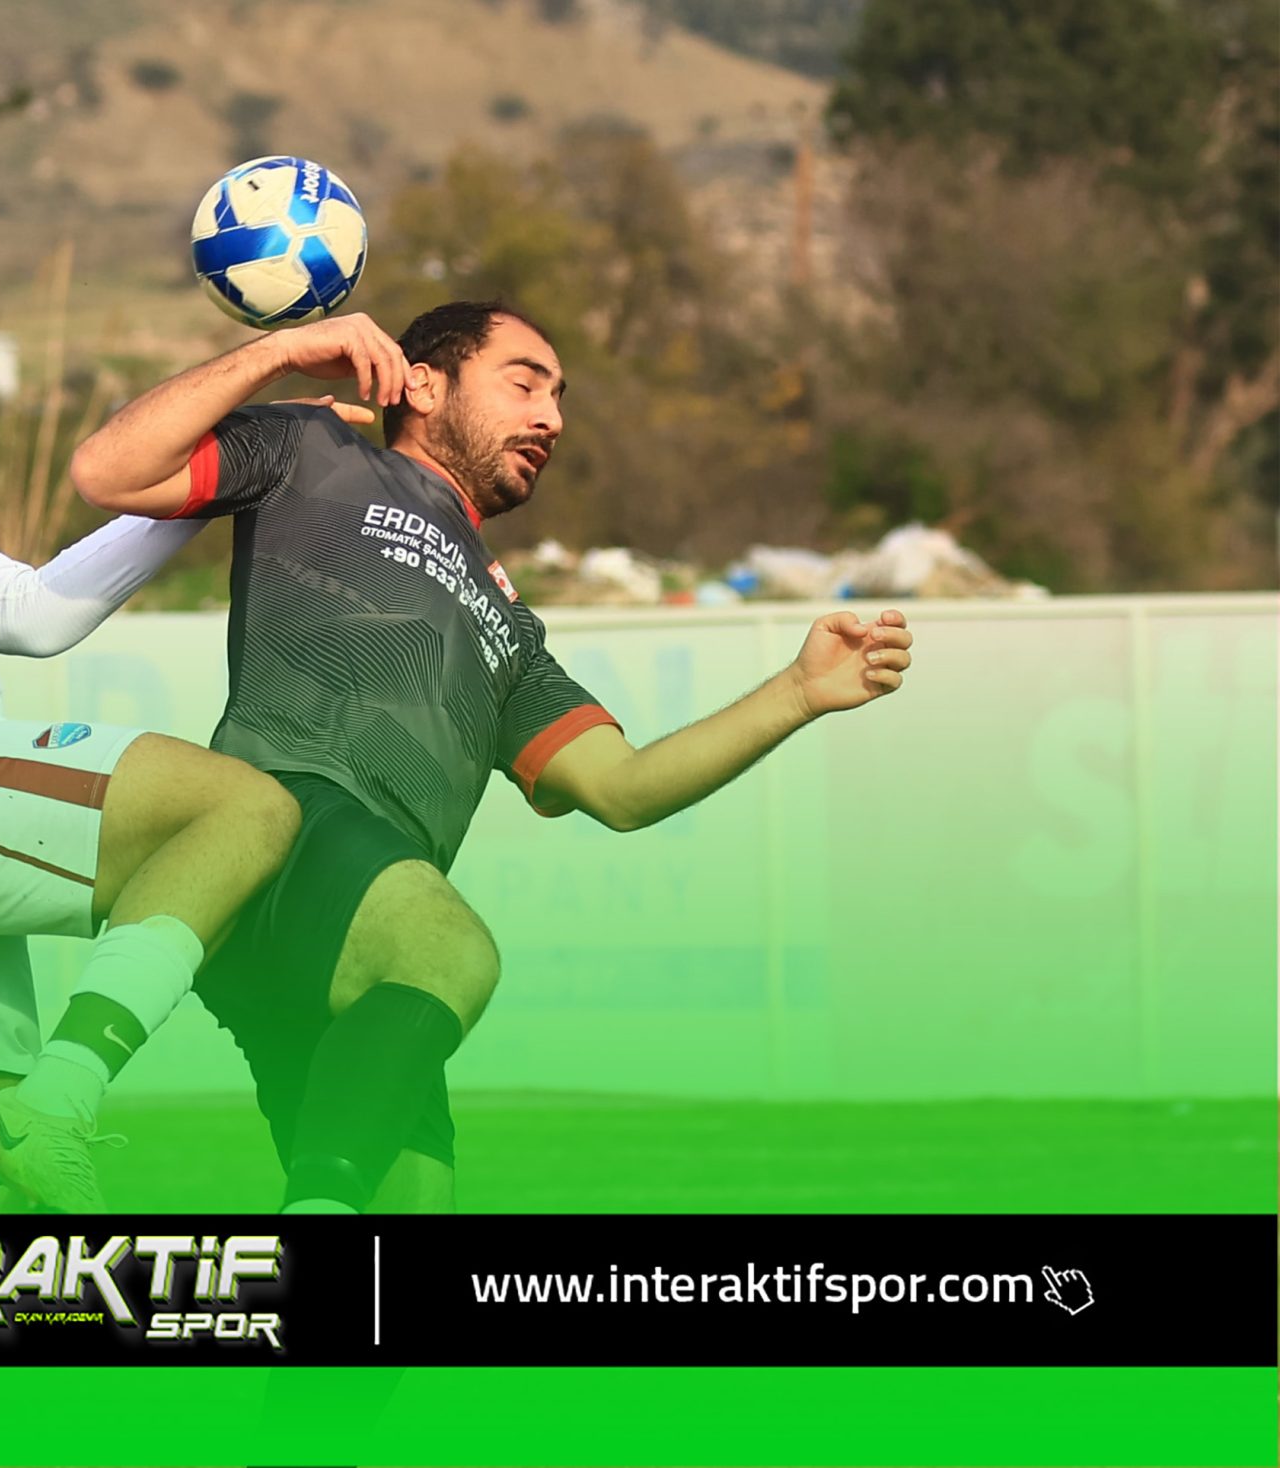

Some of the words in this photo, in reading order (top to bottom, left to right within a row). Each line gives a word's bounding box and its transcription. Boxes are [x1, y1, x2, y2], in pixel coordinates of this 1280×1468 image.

[361, 526, 422, 550] OTOMATİK
[380, 546, 421, 568] +90
[425, 559, 458, 594] 533
